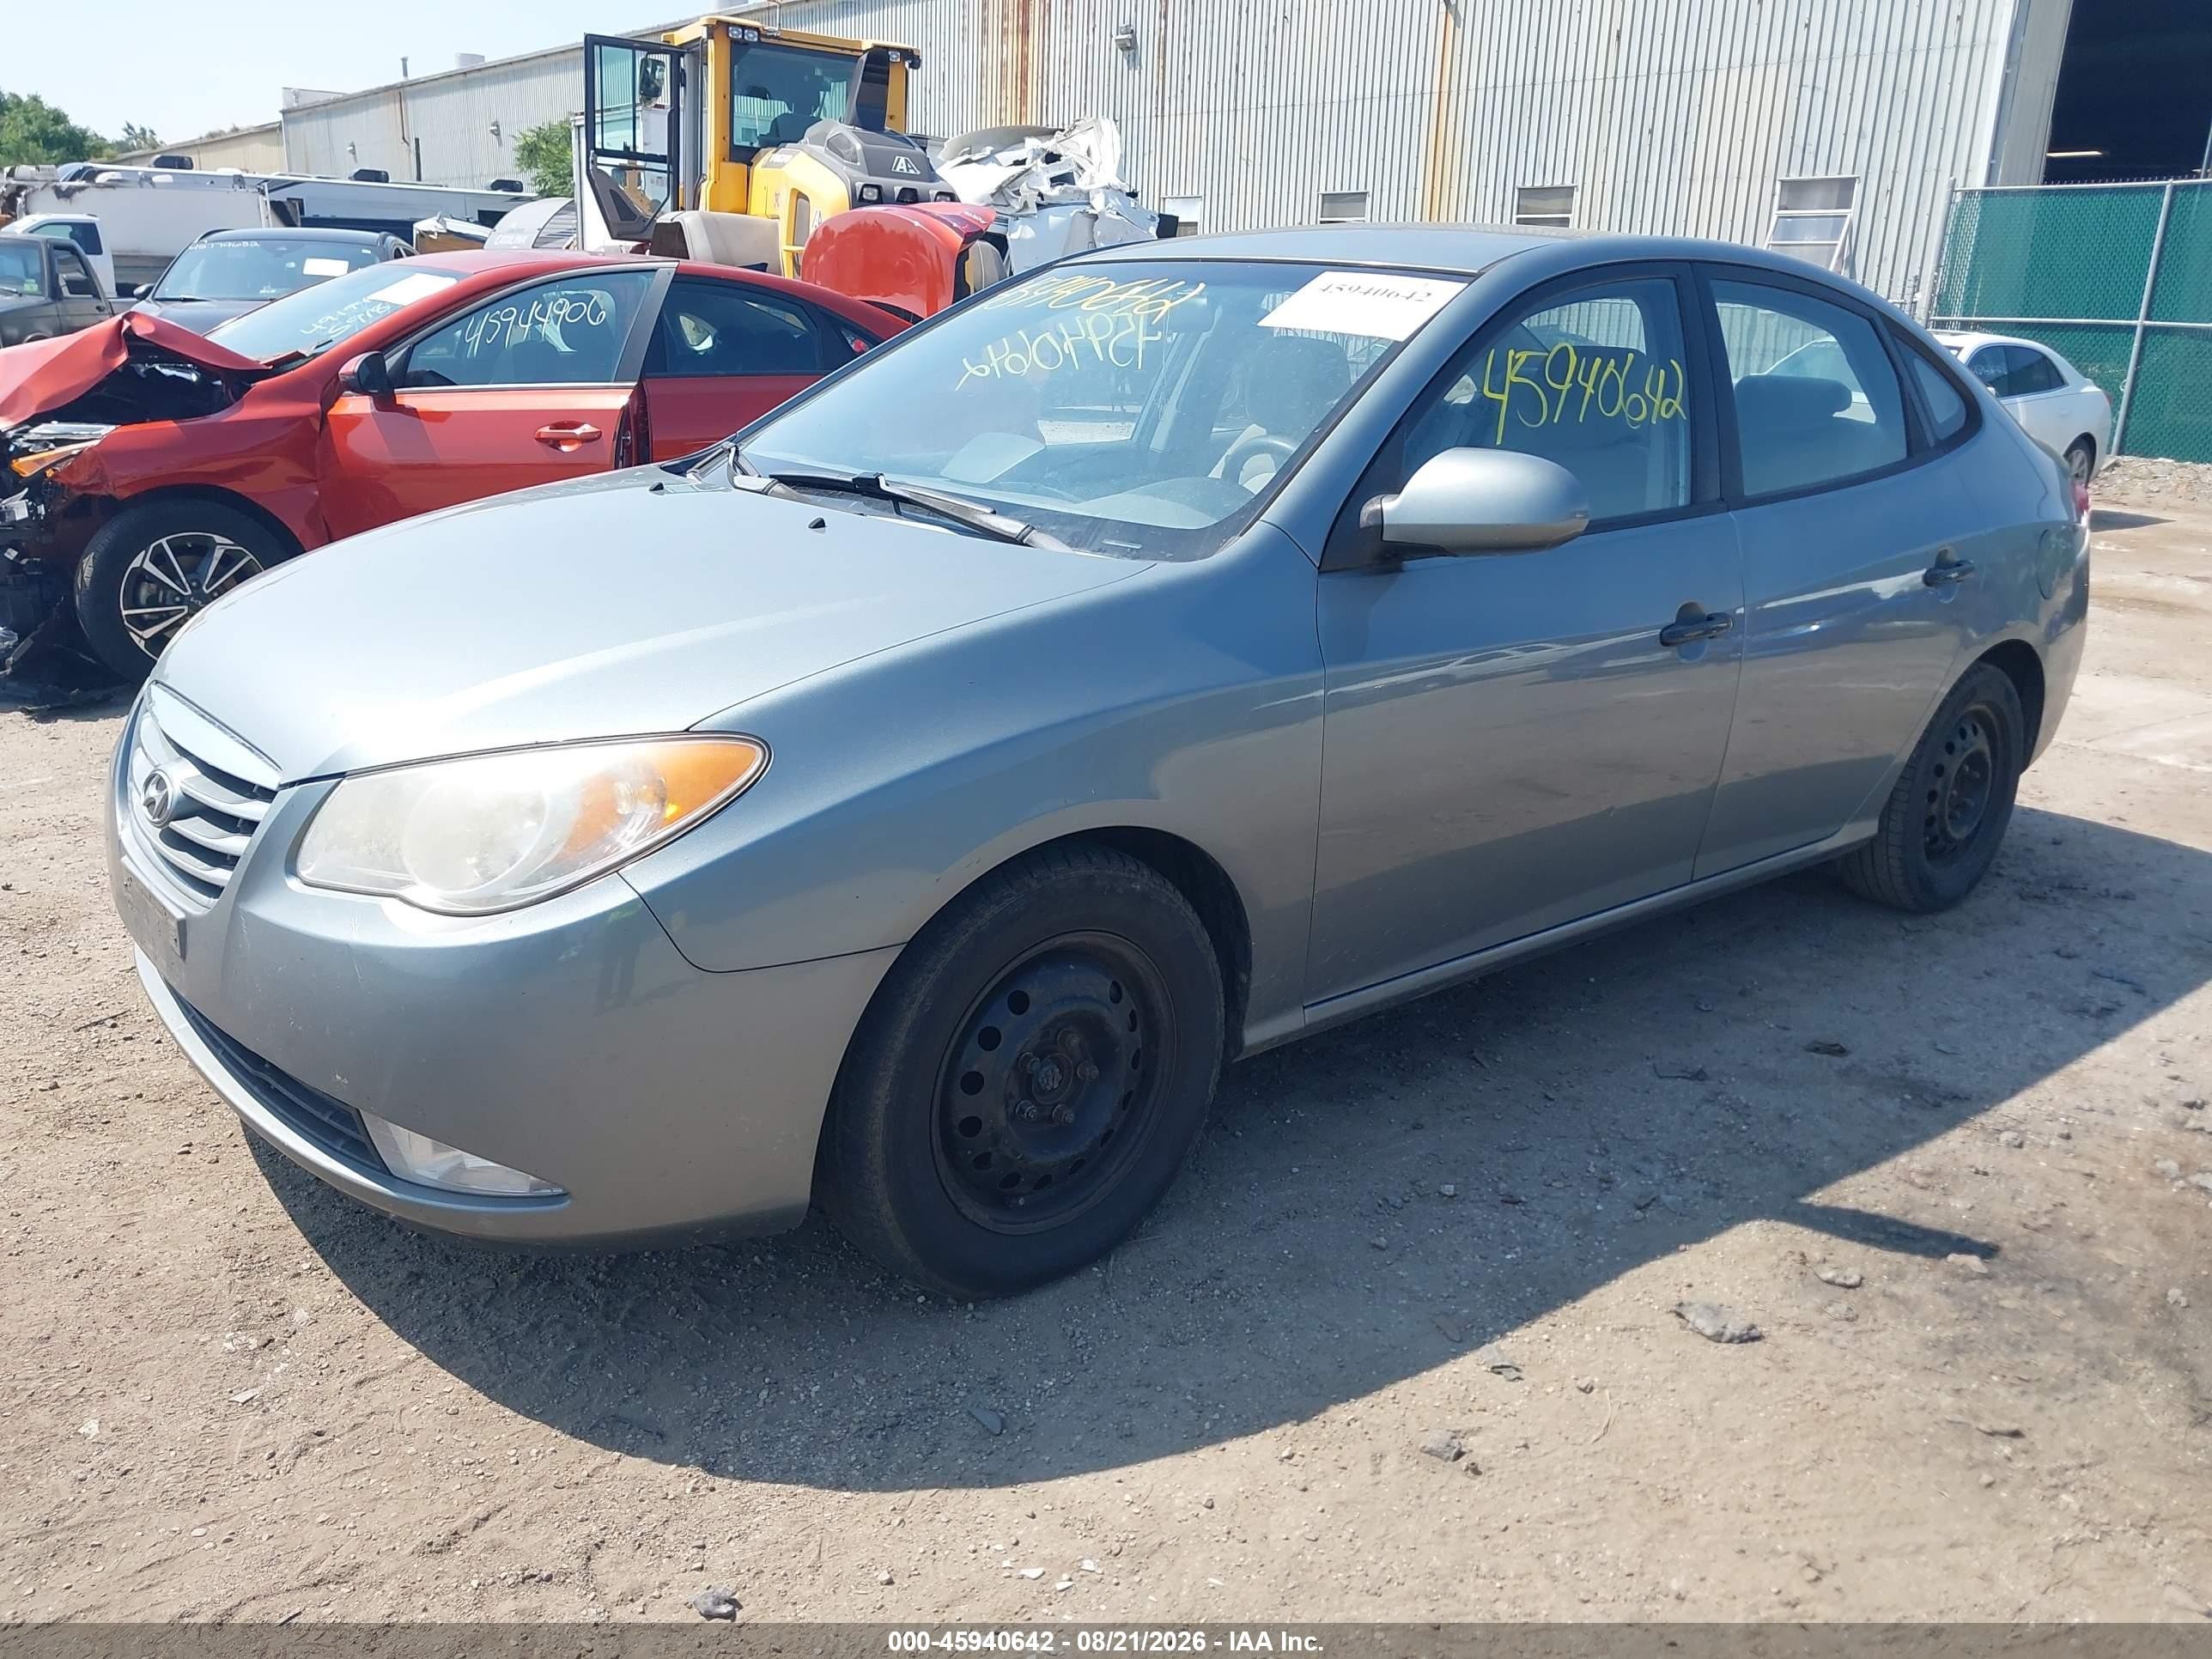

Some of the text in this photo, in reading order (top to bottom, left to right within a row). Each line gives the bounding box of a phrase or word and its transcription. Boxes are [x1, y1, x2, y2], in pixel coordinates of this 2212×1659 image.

[1319, 283, 1432, 302] 45940642
[465, 297, 606, 357] 45944906
[1483, 343, 1687, 446] 45940642
